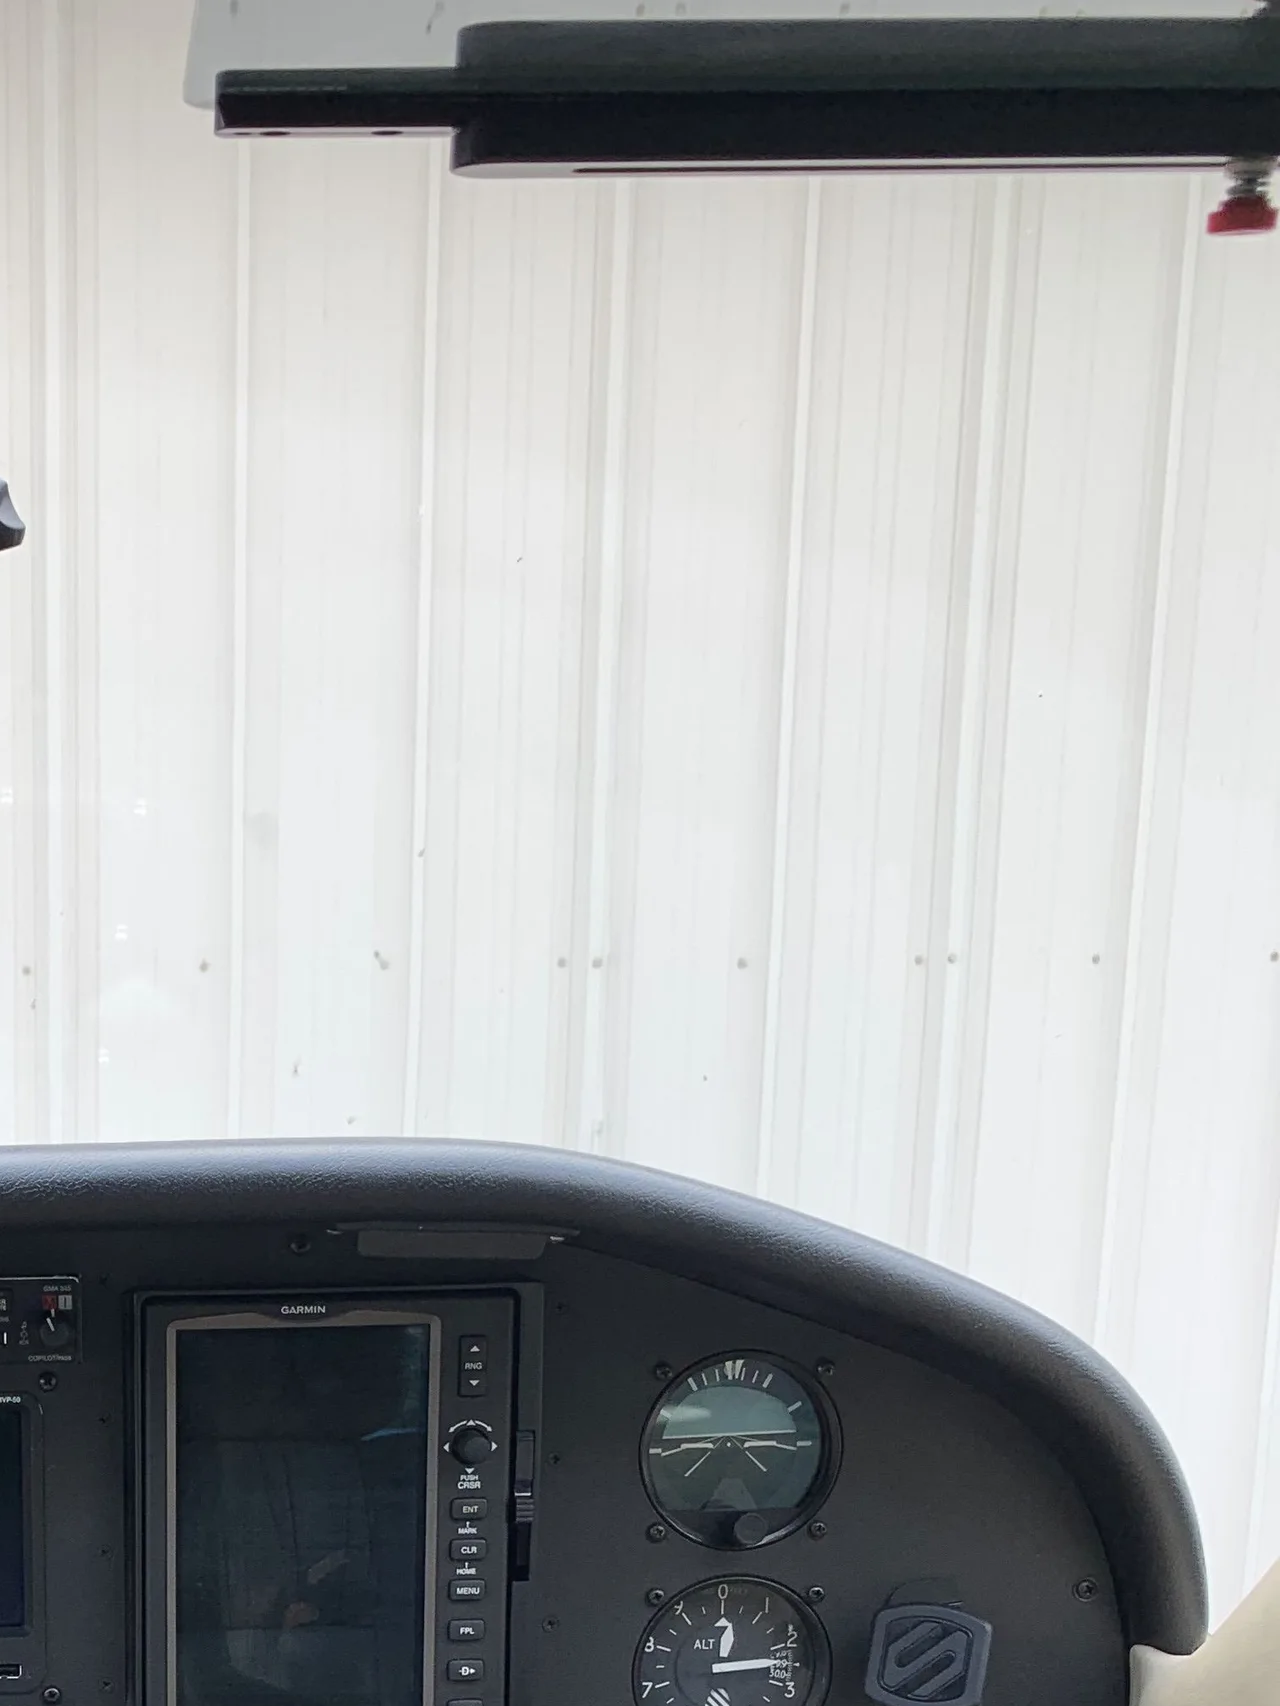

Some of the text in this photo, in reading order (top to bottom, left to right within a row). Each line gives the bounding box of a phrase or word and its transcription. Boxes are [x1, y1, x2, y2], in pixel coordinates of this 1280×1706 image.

[281, 1305, 326, 1314] GARMIN
[465, 1362, 483, 1370] RNG
[462, 1505, 478, 1513] ENT
[461, 1545, 477, 1554] CLR
[456, 1587, 480, 1595] MENU
[460, 1626, 475, 1635] FPL
[694, 1639, 714, 1649] ALT
